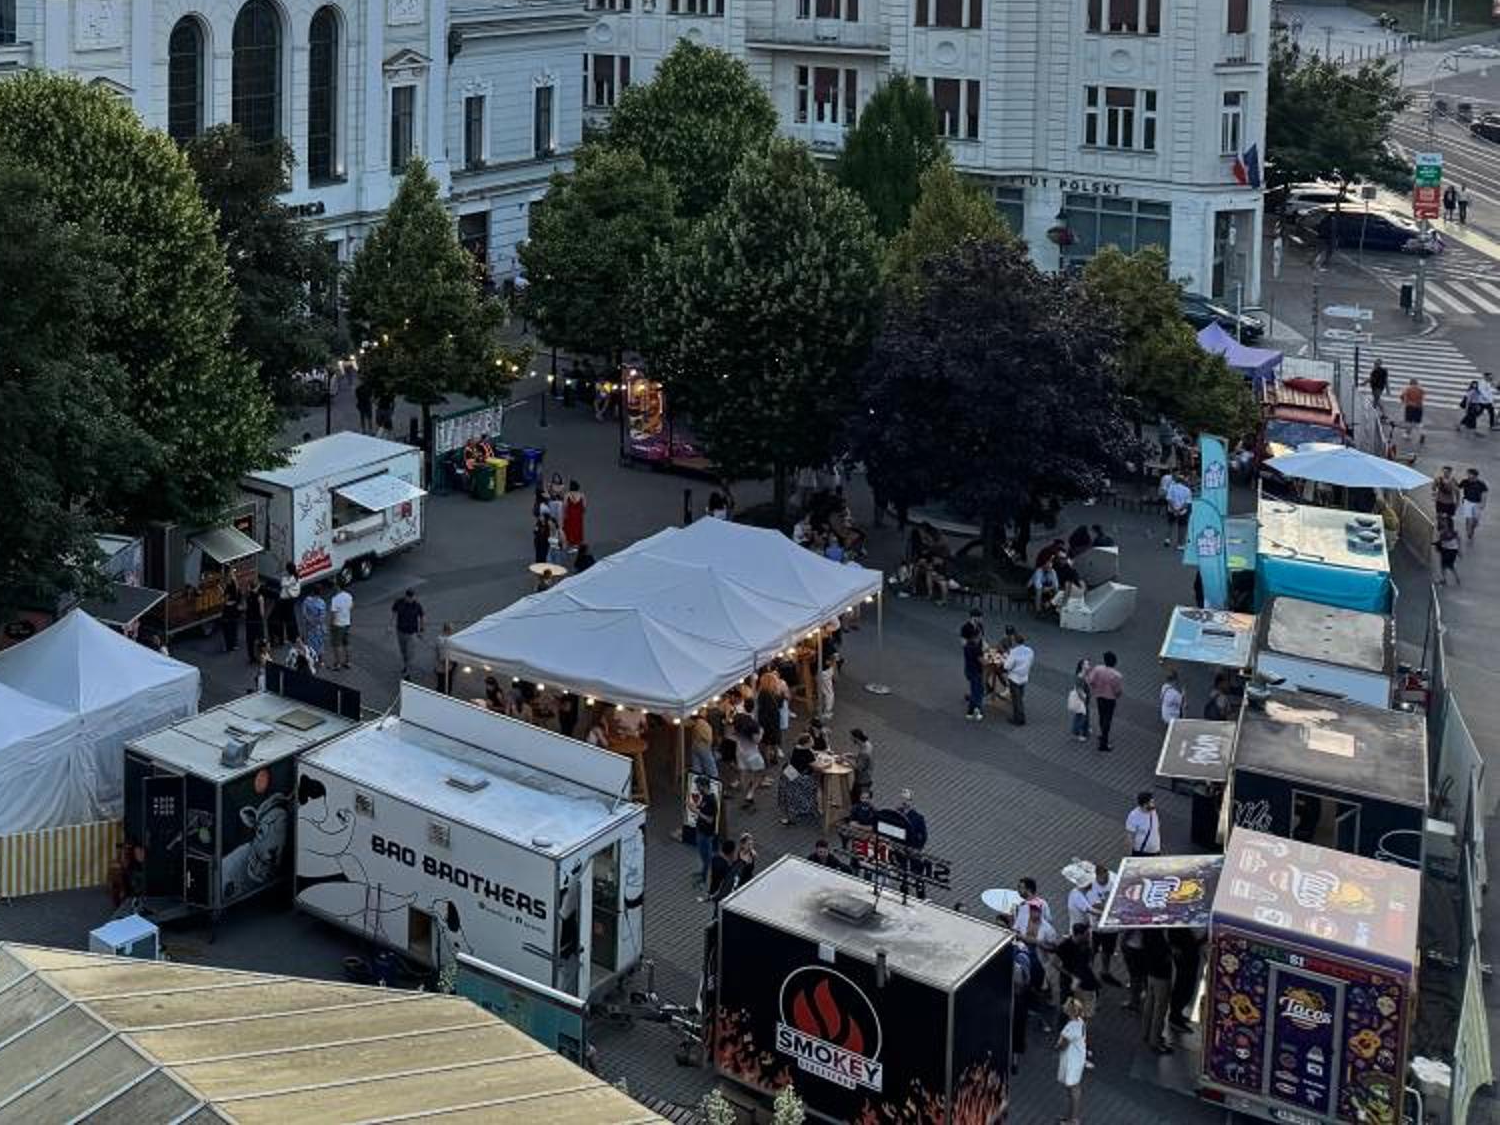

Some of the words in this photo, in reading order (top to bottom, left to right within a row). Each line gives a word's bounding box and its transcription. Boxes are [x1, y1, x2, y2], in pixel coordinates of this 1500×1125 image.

[1060, 179, 1121, 196] POLSKI
[422, 854, 547, 921] BROTHERS
[1279, 996, 1333, 1025] Tacos
[779, 1030, 879, 1083] SMOKEY
